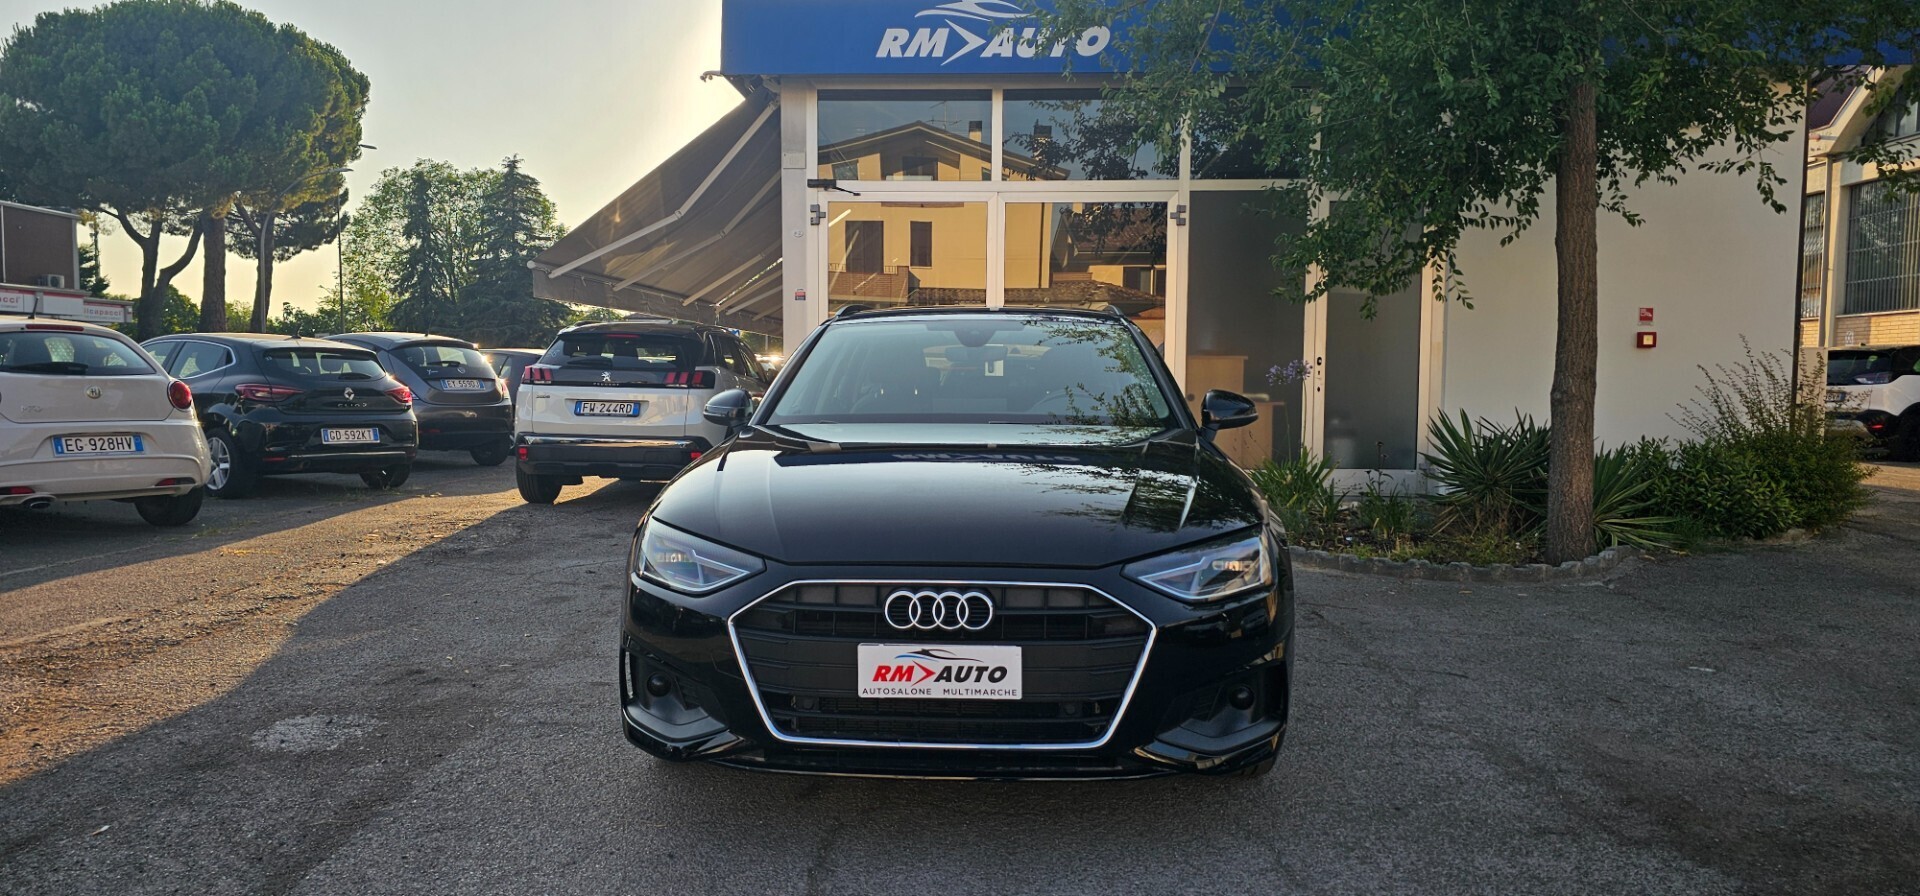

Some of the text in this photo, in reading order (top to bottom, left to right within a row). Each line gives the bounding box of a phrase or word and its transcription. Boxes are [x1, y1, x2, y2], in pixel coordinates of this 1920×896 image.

[876, 28, 949, 57] RM
[582, 402, 632, 414] FW 244RD
[329, 430, 372, 440] GD 592KT
[65, 437, 132, 452] EG 928HV
[872, 665, 1008, 683] RM AUTO
[943, 688, 1018, 697] MULTIMARCHE
